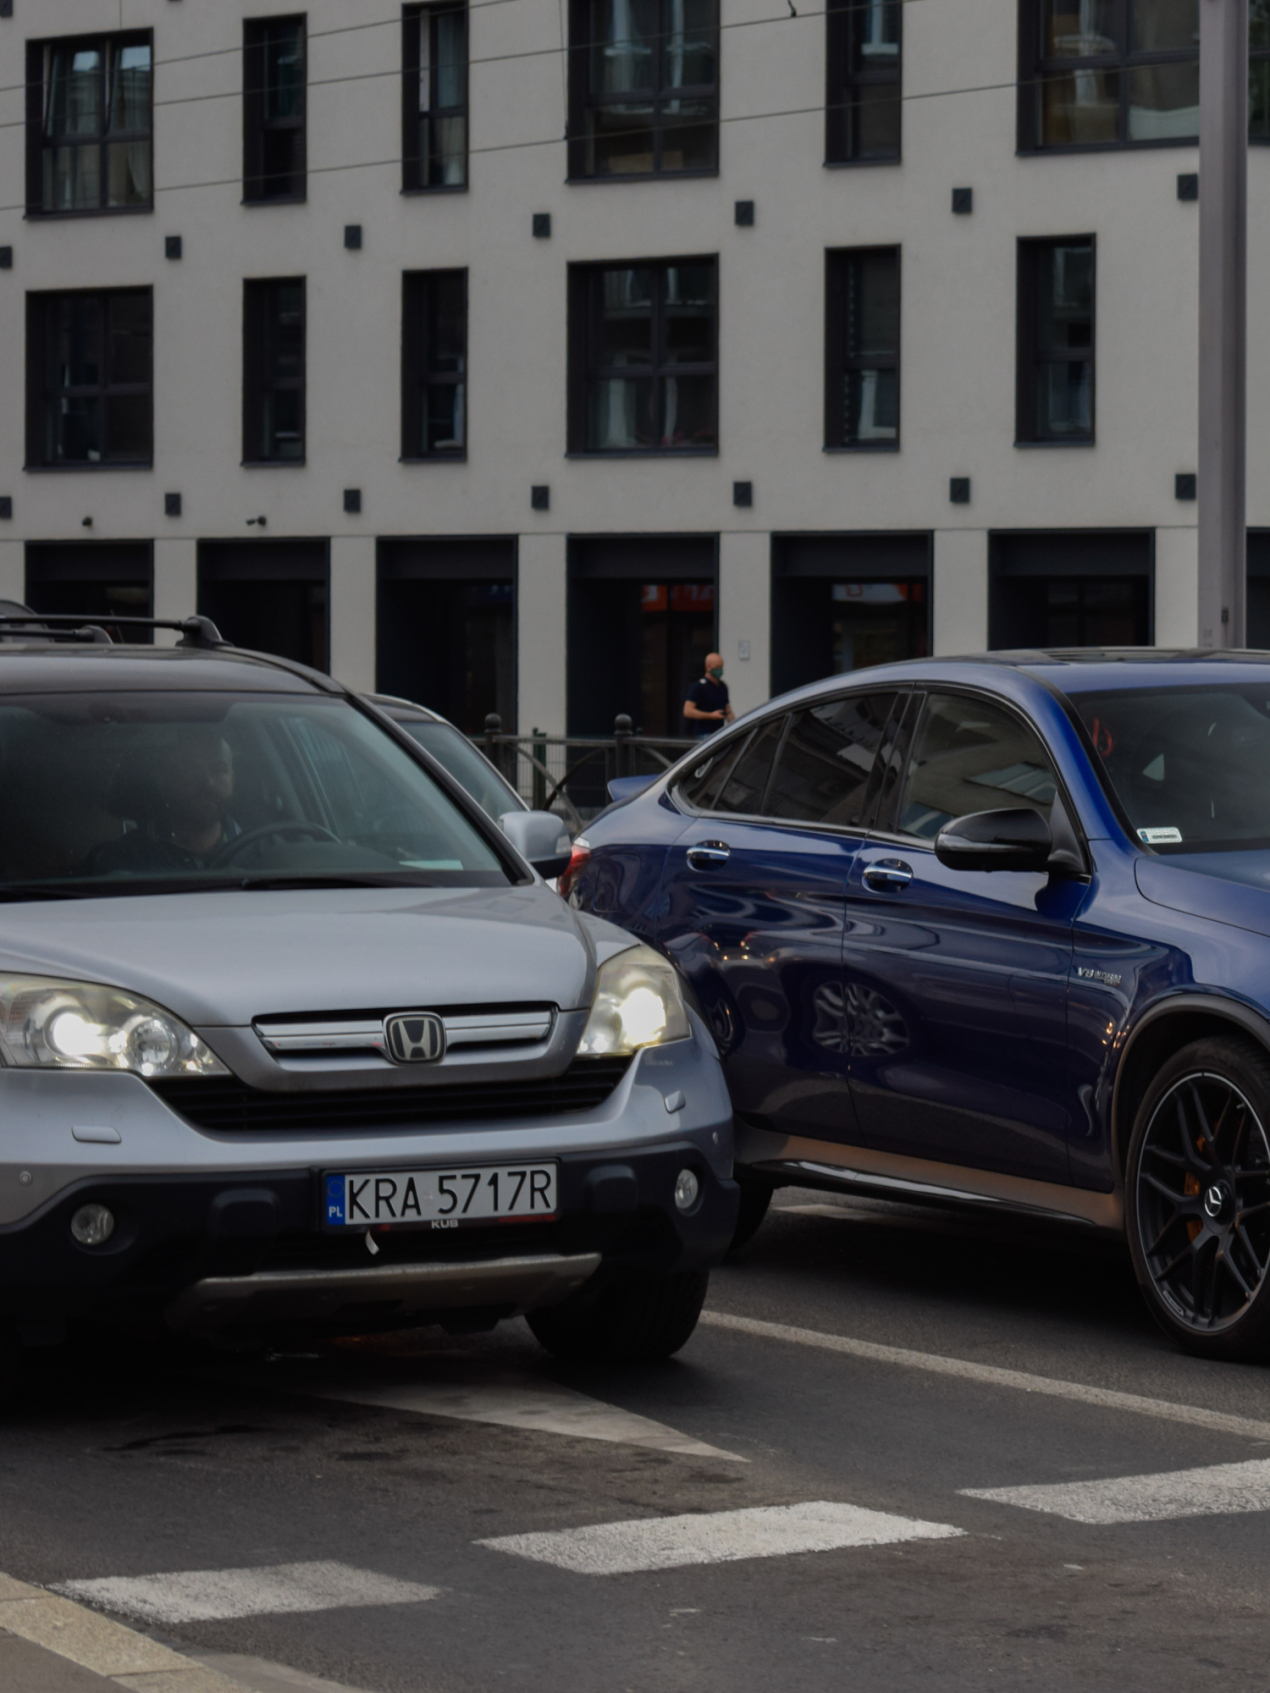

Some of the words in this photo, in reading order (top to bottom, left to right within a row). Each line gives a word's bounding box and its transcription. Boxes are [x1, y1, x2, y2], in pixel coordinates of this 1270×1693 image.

[349, 1177, 422, 1219] KRA
[437, 1169, 552, 1214] 5717R
[328, 1205, 343, 1218] PL
